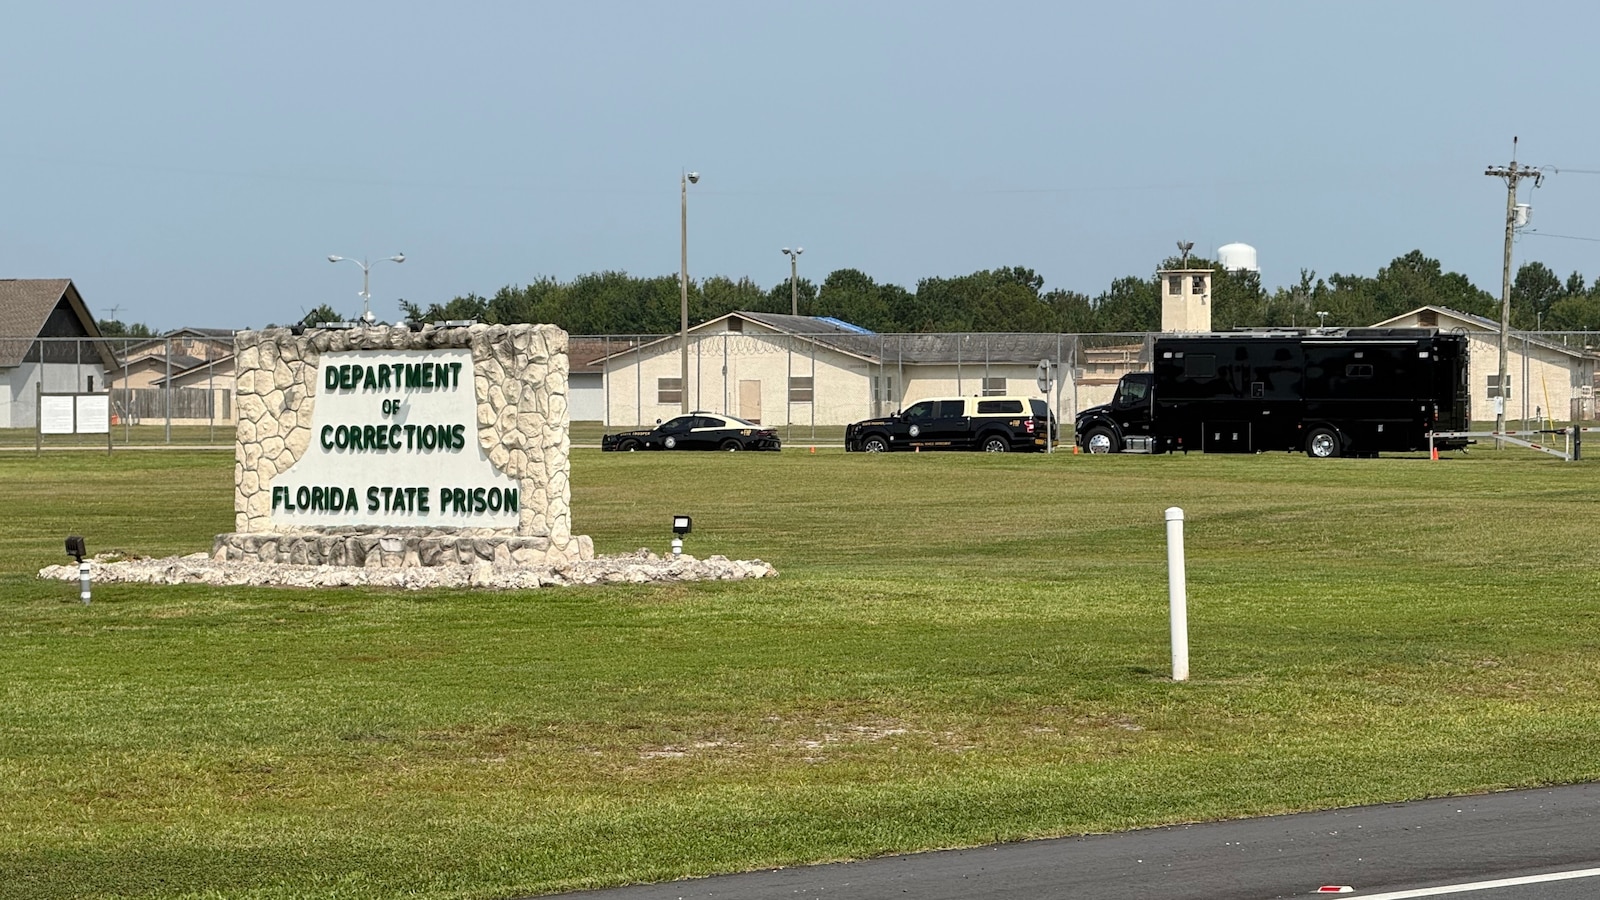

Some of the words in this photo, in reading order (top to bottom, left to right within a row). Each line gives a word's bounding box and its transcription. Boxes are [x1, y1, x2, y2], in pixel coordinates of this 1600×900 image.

[325, 362, 462, 391] DEPARTMENT
[382, 398, 401, 416] OF
[320, 423, 466, 451] CORRECTIONS
[271, 485, 359, 512] FLORIDA
[366, 486, 430, 513] STATE
[440, 486, 518, 513] PRISON
